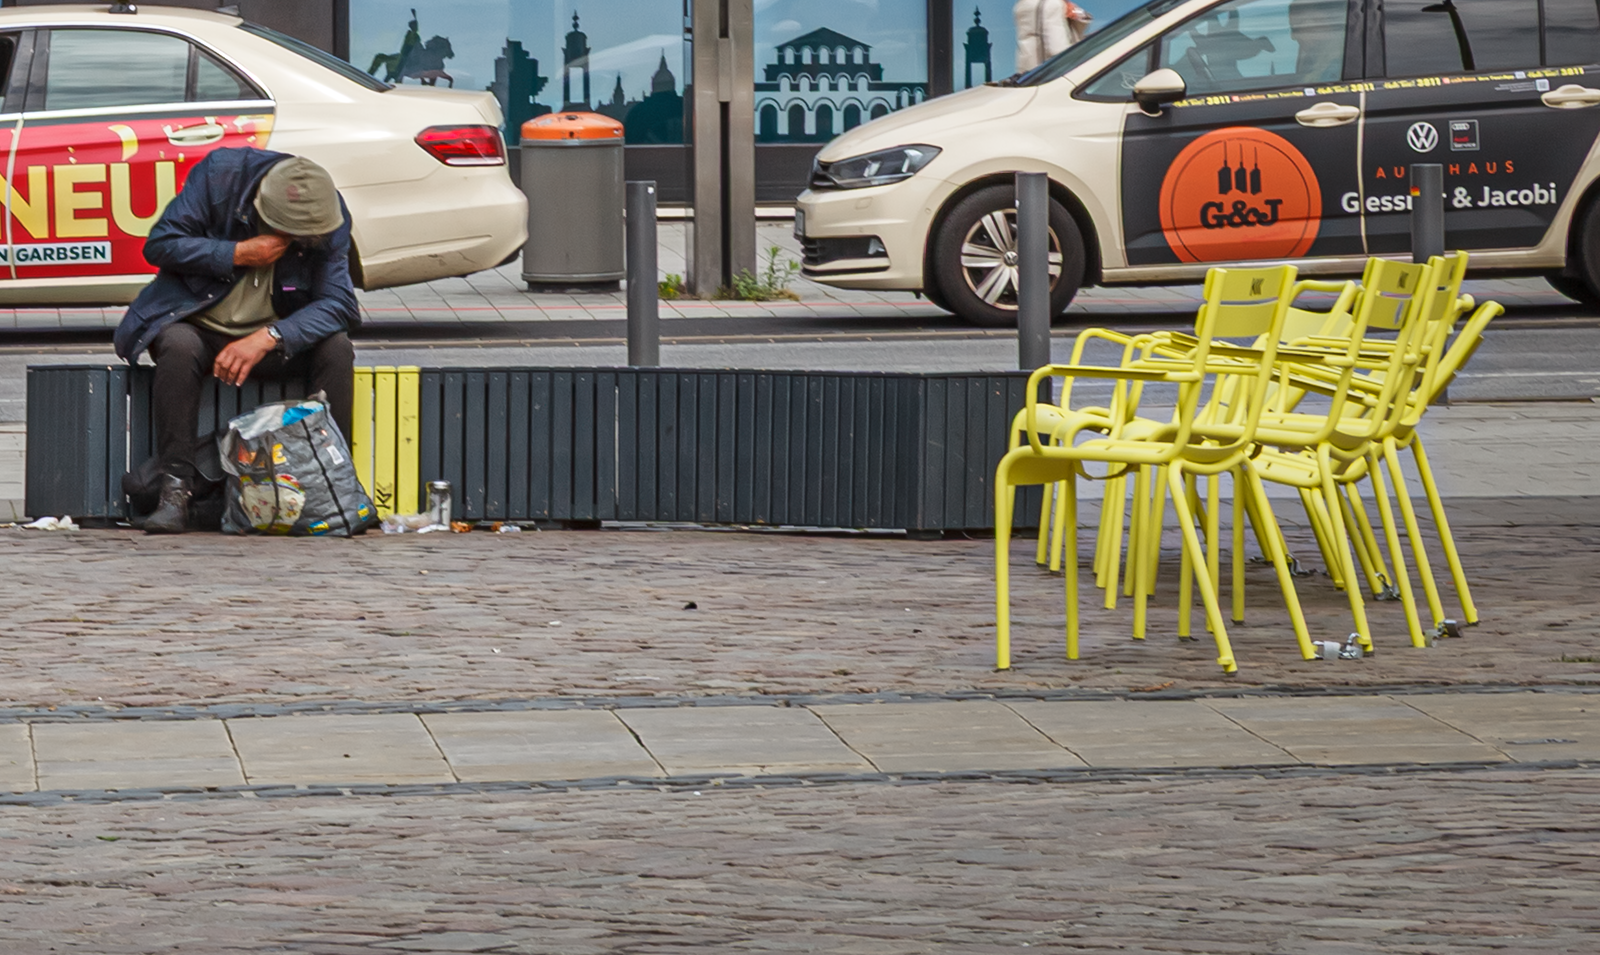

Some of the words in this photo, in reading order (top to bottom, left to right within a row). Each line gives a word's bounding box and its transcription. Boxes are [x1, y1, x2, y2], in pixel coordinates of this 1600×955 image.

[1375, 160, 1515, 179] AUHAUS
[1452, 186, 1473, 208] &
[1477, 182, 1557, 208] Jacobi
[1200, 198, 1284, 229] G&J
[15, 245, 107, 263] GARBSEN
